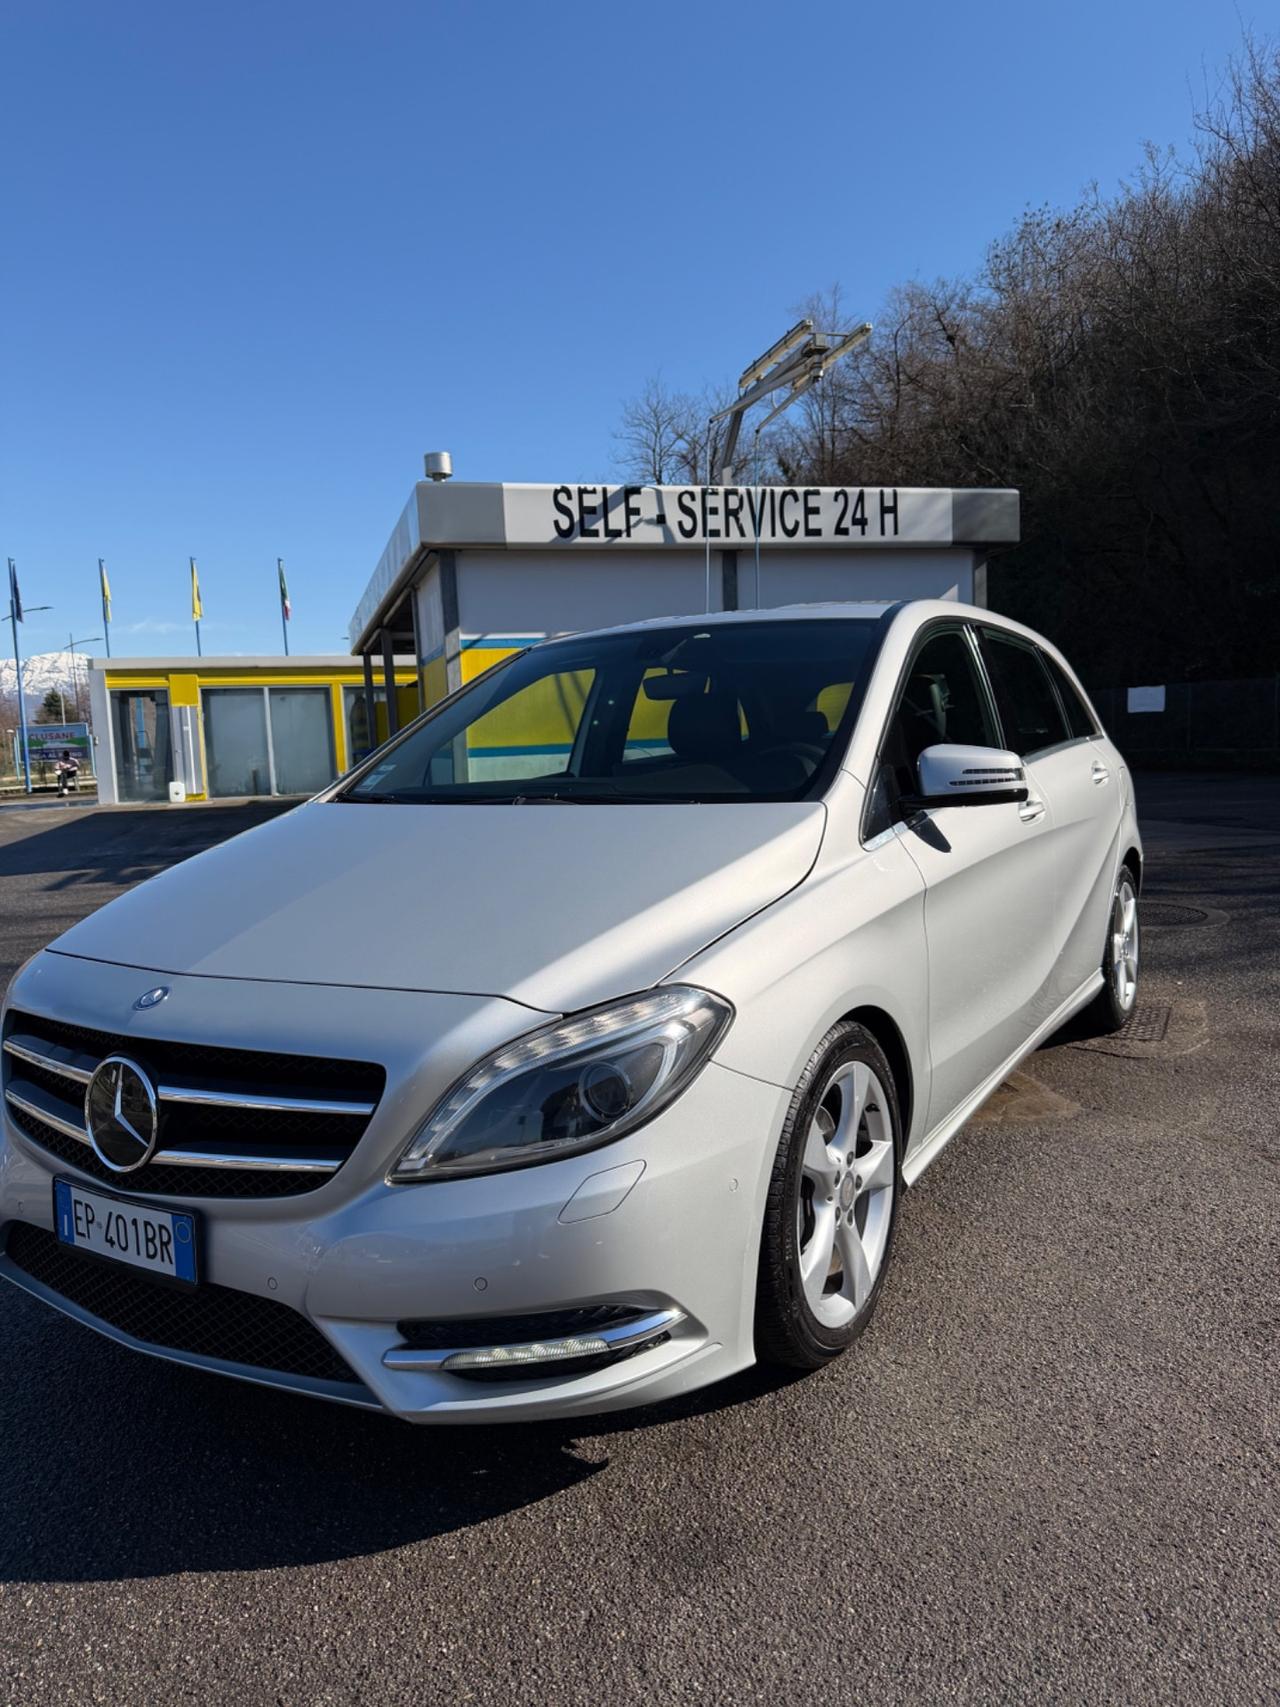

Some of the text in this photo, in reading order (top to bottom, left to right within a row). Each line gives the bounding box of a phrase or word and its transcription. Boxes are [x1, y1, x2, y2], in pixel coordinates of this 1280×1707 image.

[553, 485, 643, 538] SELF
[677, 486, 822, 538] SERVICE
[833, 488, 868, 537] 24
[879, 488, 899, 537] H
[73, 1199, 95, 1240] EP
[105, 1211, 173, 1265] 401BR
